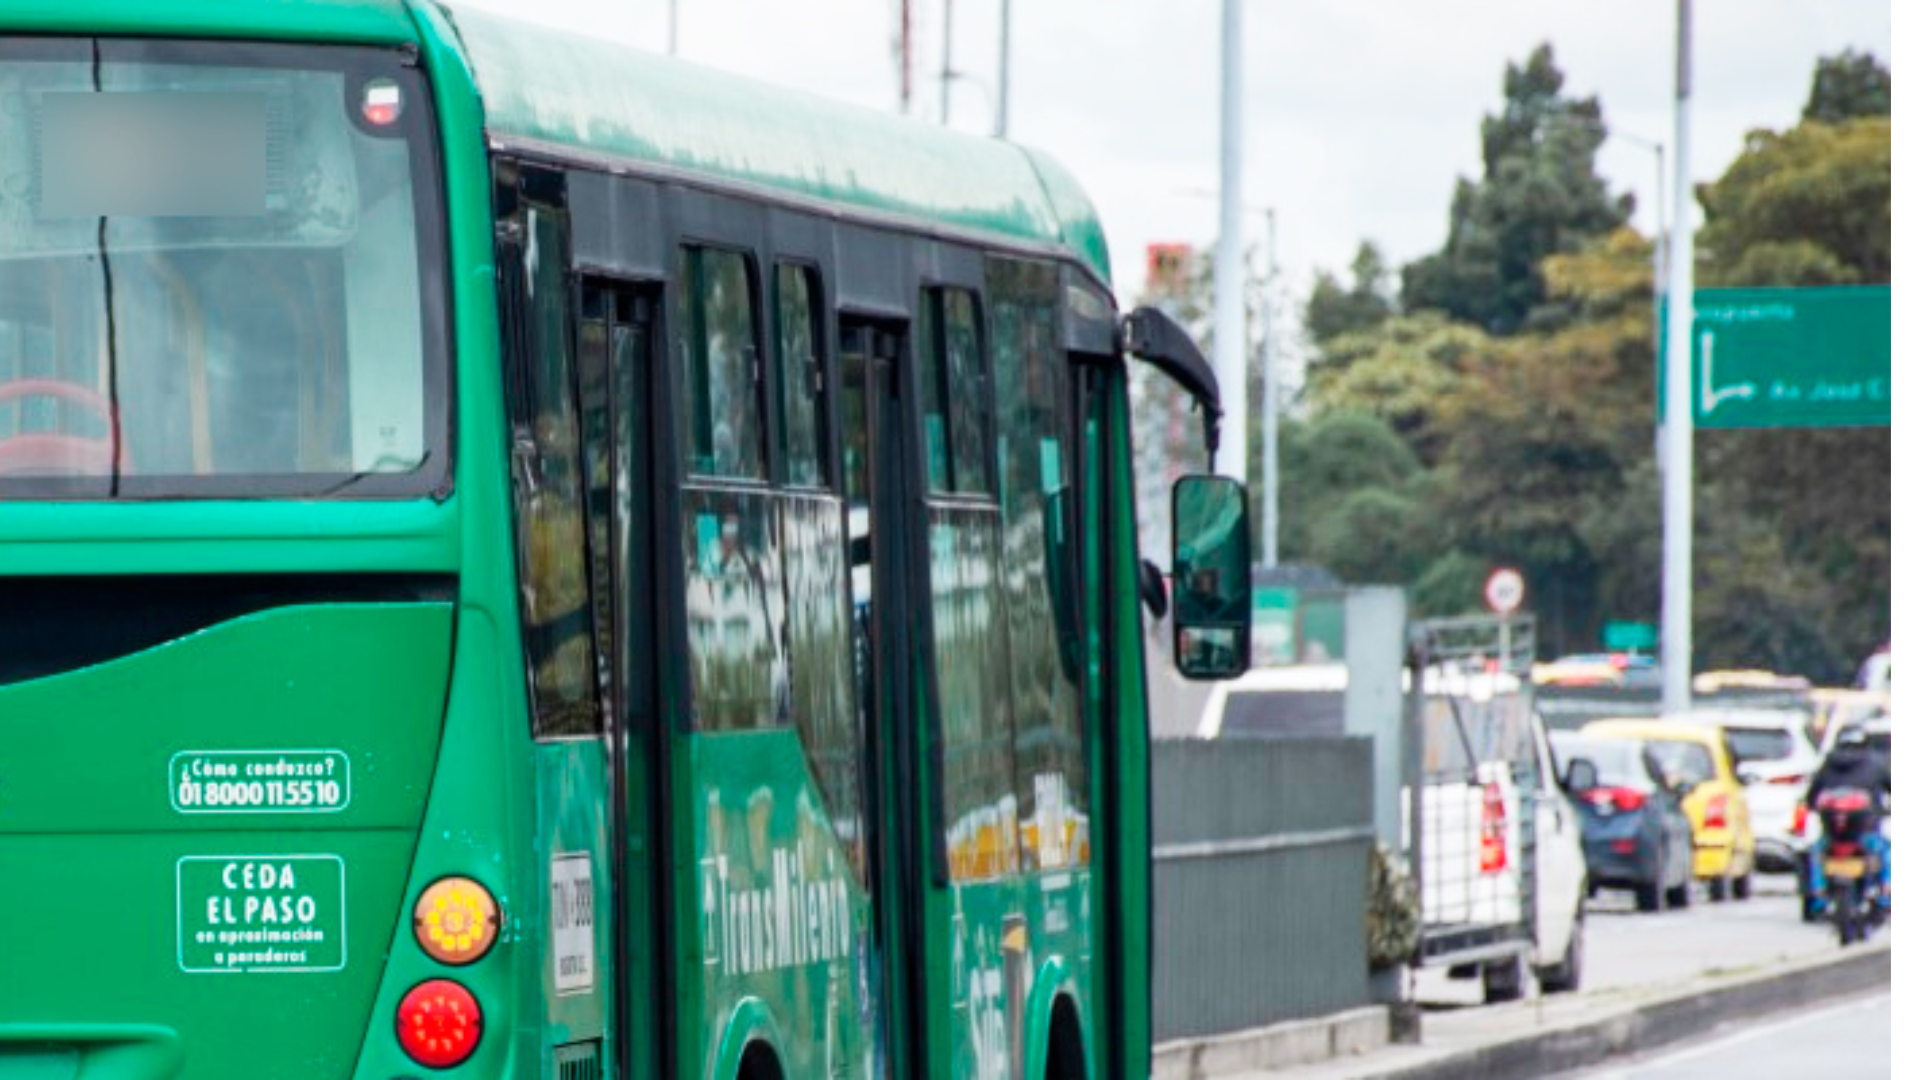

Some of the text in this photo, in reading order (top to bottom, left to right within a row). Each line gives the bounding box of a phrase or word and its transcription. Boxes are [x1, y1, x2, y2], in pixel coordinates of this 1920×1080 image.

[222, 862, 296, 890] CEDA
[206, 895, 316, 924] EL PASO
[718, 838, 851, 977] TransMilenio
[195, 929, 215, 943] en
[214, 947, 308, 967] a paraderos
